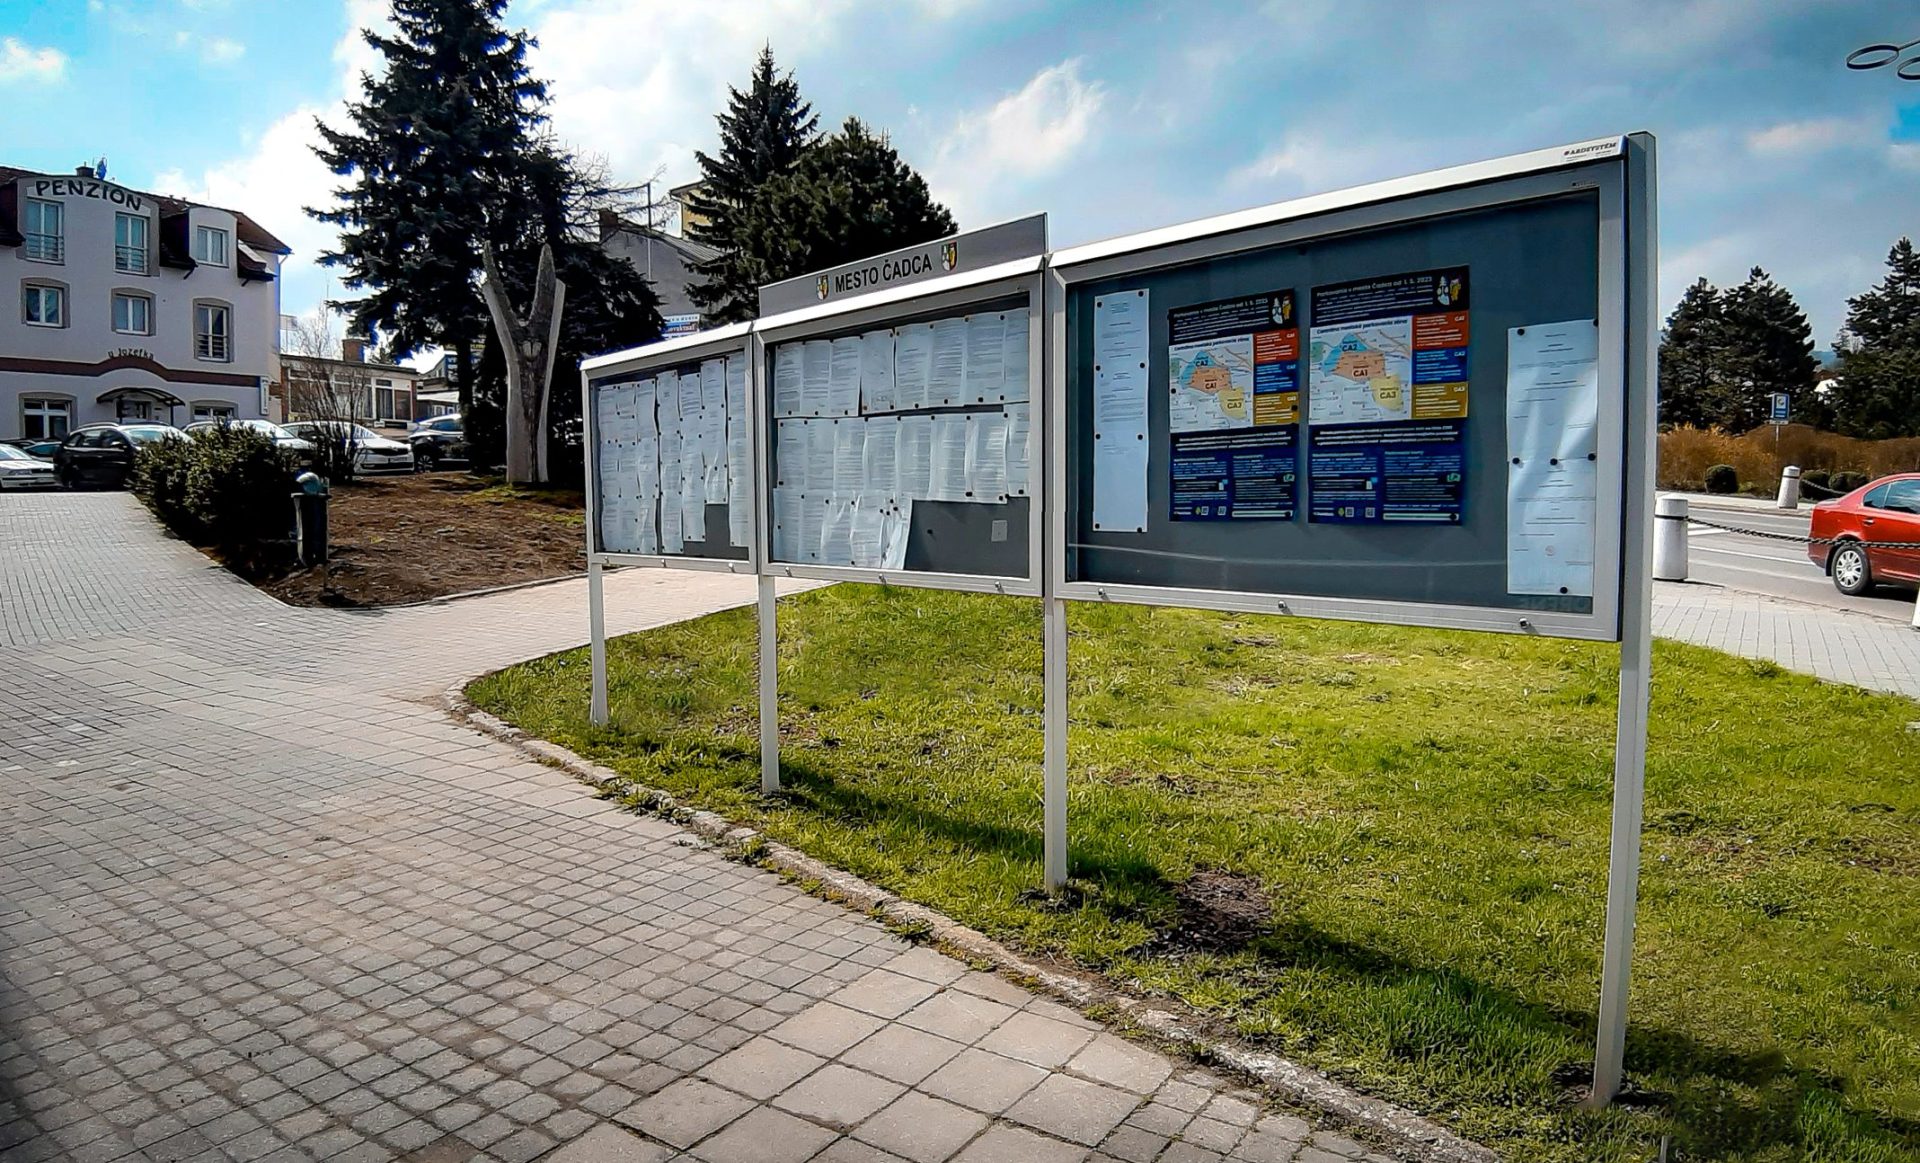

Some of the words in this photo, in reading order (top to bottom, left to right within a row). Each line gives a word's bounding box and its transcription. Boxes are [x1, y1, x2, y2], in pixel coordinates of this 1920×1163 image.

[36, 180, 142, 211] PENZION
[835, 267, 878, 293] MESTO
[882, 253, 933, 281] ČADCA
[1341, 343, 1357, 351] CA2
[1353, 369, 1368, 377] CA1
[1205, 382, 1217, 390] CA1
